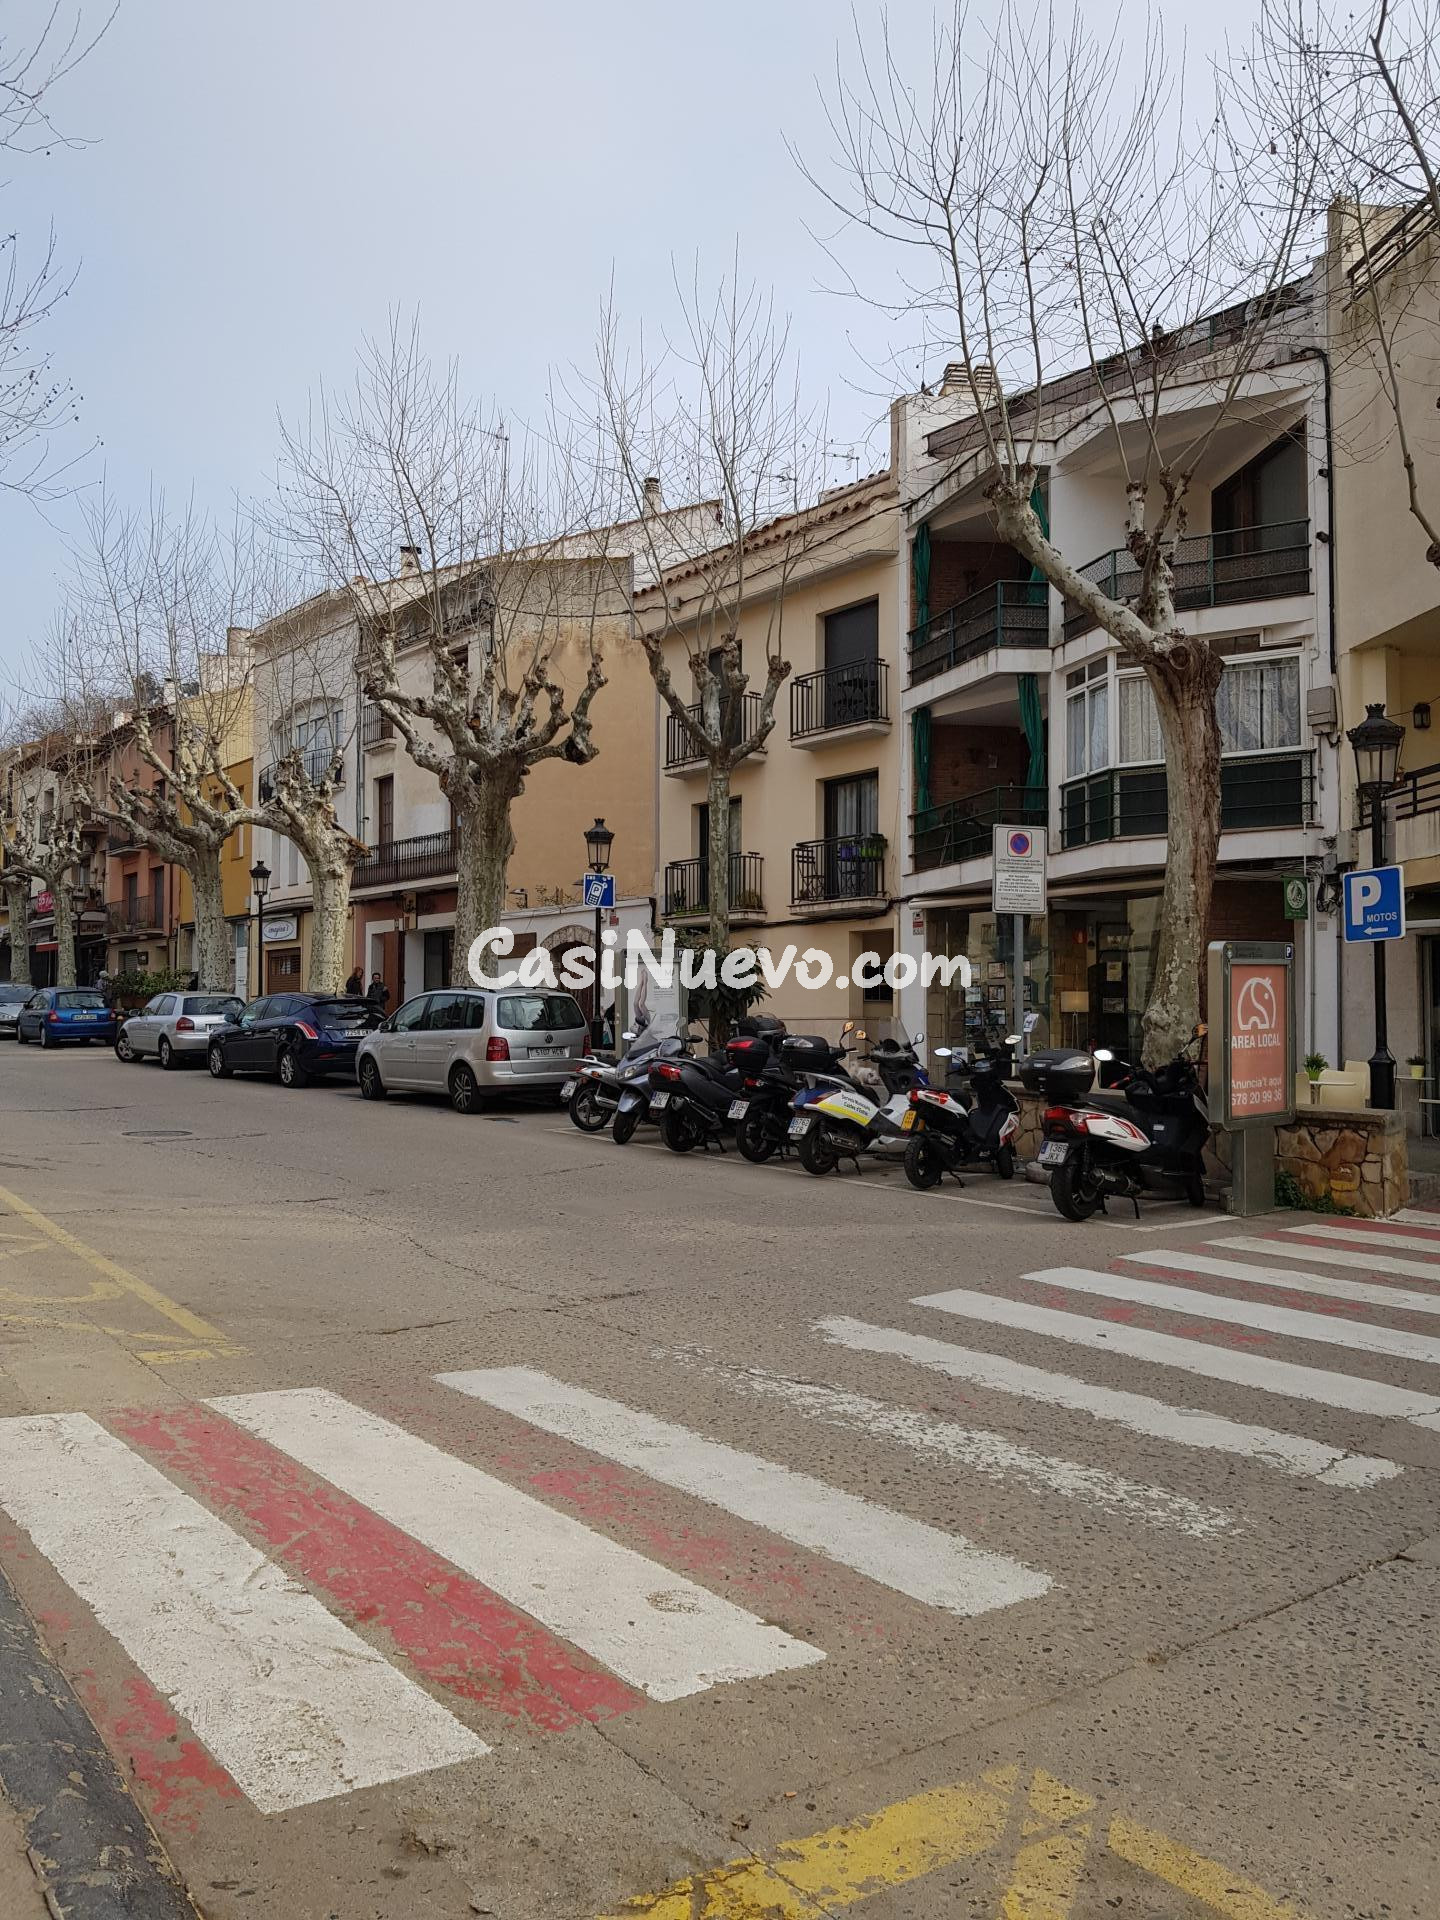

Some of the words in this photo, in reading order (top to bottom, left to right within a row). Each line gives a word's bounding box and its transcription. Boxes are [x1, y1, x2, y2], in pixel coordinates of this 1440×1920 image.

[1351, 876, 1381, 925] P
[1366, 911, 1398, 923] MOTOS
[1231, 1035, 1256, 1049] AREA
[1257, 1032, 1281, 1048] LOCAL
